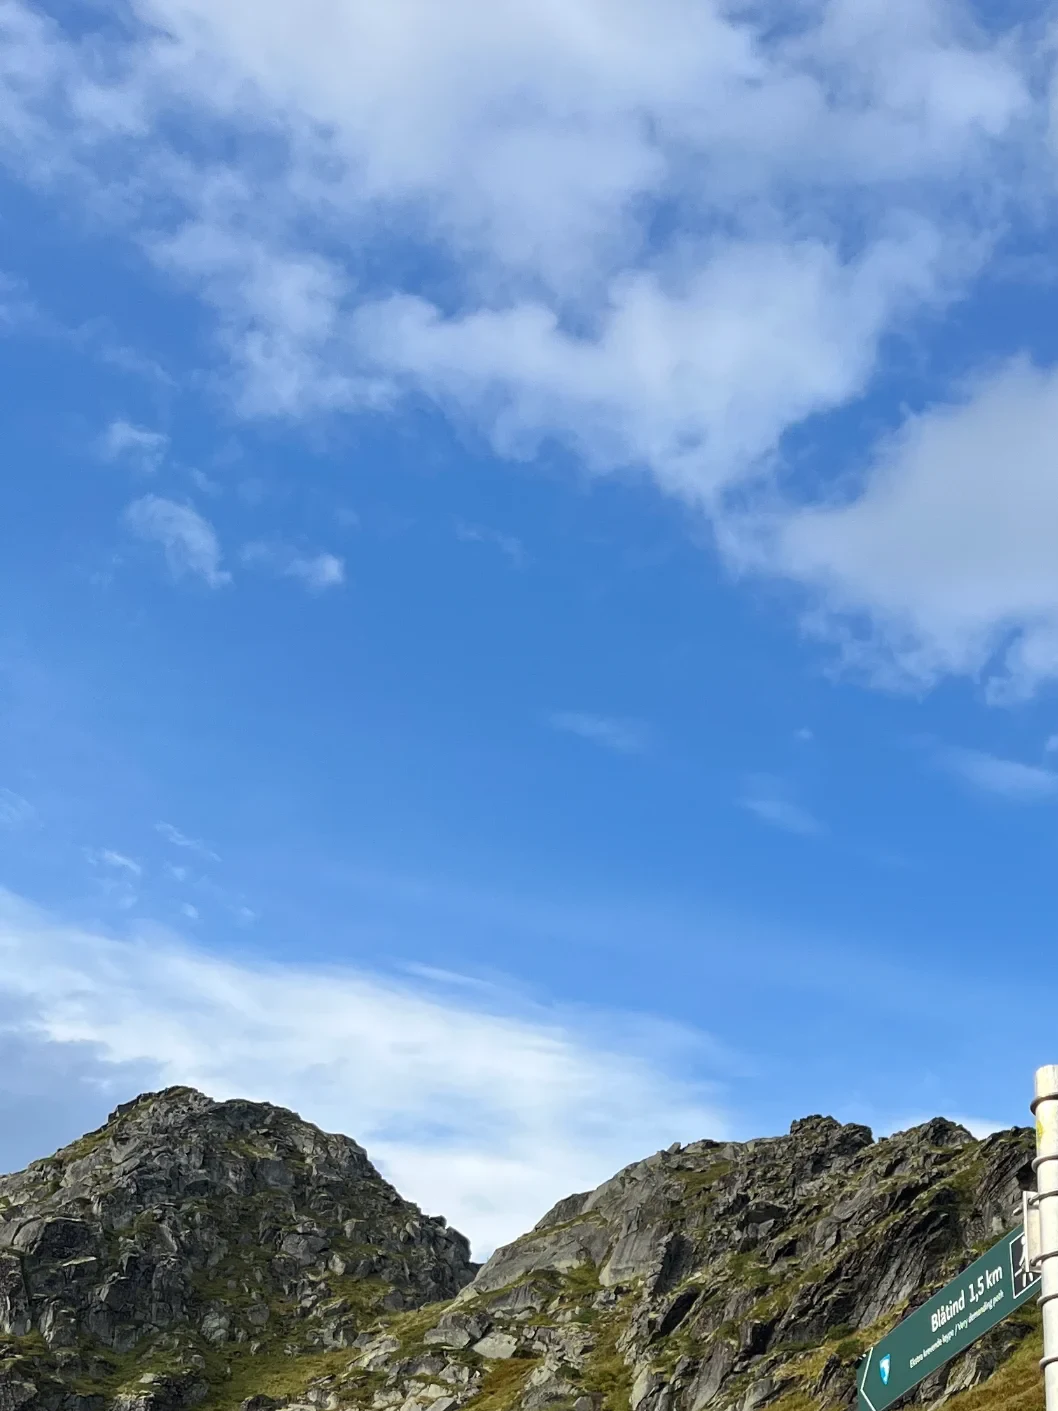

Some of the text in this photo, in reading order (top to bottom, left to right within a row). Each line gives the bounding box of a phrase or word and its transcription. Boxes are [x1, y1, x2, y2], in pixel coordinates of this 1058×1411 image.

[909, 1353, 924, 1369] Ekstra
[922, 1337, 943, 1358] krevende
[941, 1329, 955, 1343] løype
[957, 1318, 968, 1331] Very
[968, 1298, 993, 1324] demanding
[992, 1289, 1005, 1307] path
[930, 1265, 1003, 1333] Blåtind 1,5 km
